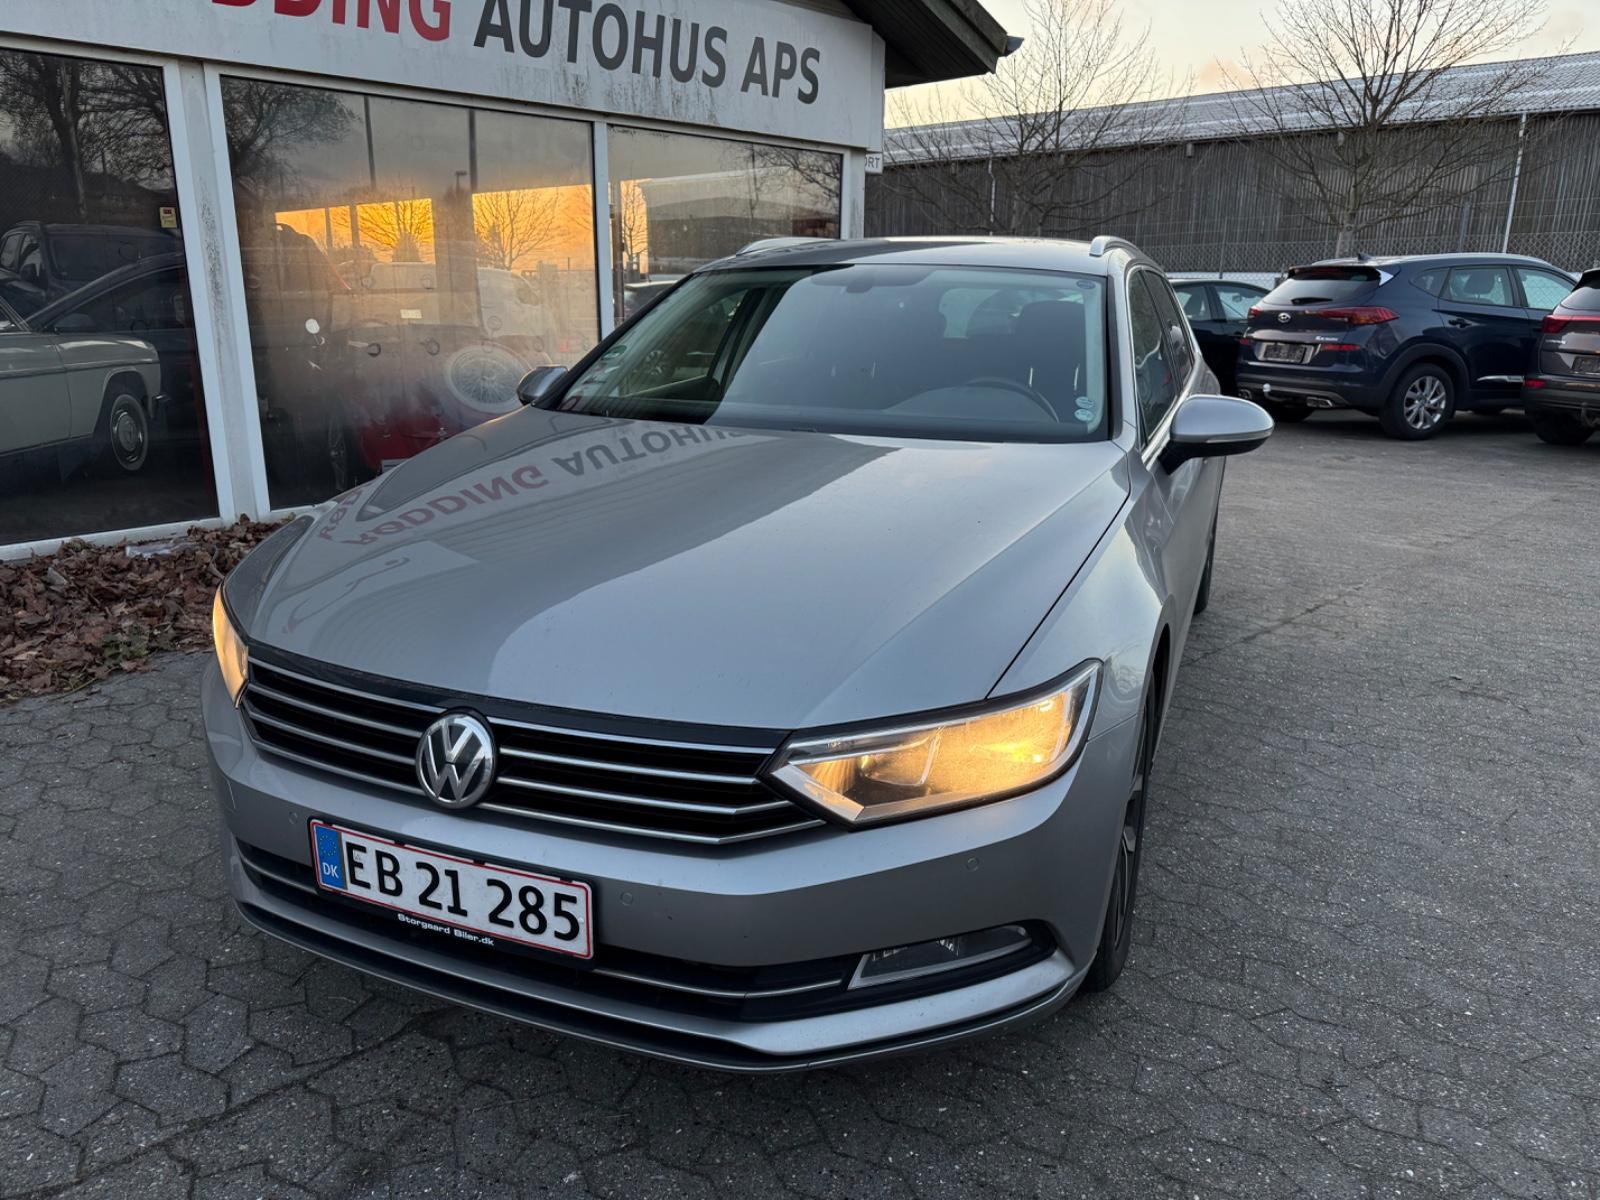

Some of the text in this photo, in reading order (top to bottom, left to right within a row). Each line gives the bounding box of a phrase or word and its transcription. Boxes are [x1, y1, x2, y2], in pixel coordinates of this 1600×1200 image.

[473, 0, 728, 89] AUTOHUS
[740, 36, 821, 105] APS
[322, 862, 339, 879] DK
[345, 841, 580, 942] EB 21 285
[397, 913, 495, 946] Storgaard Biler.dk
